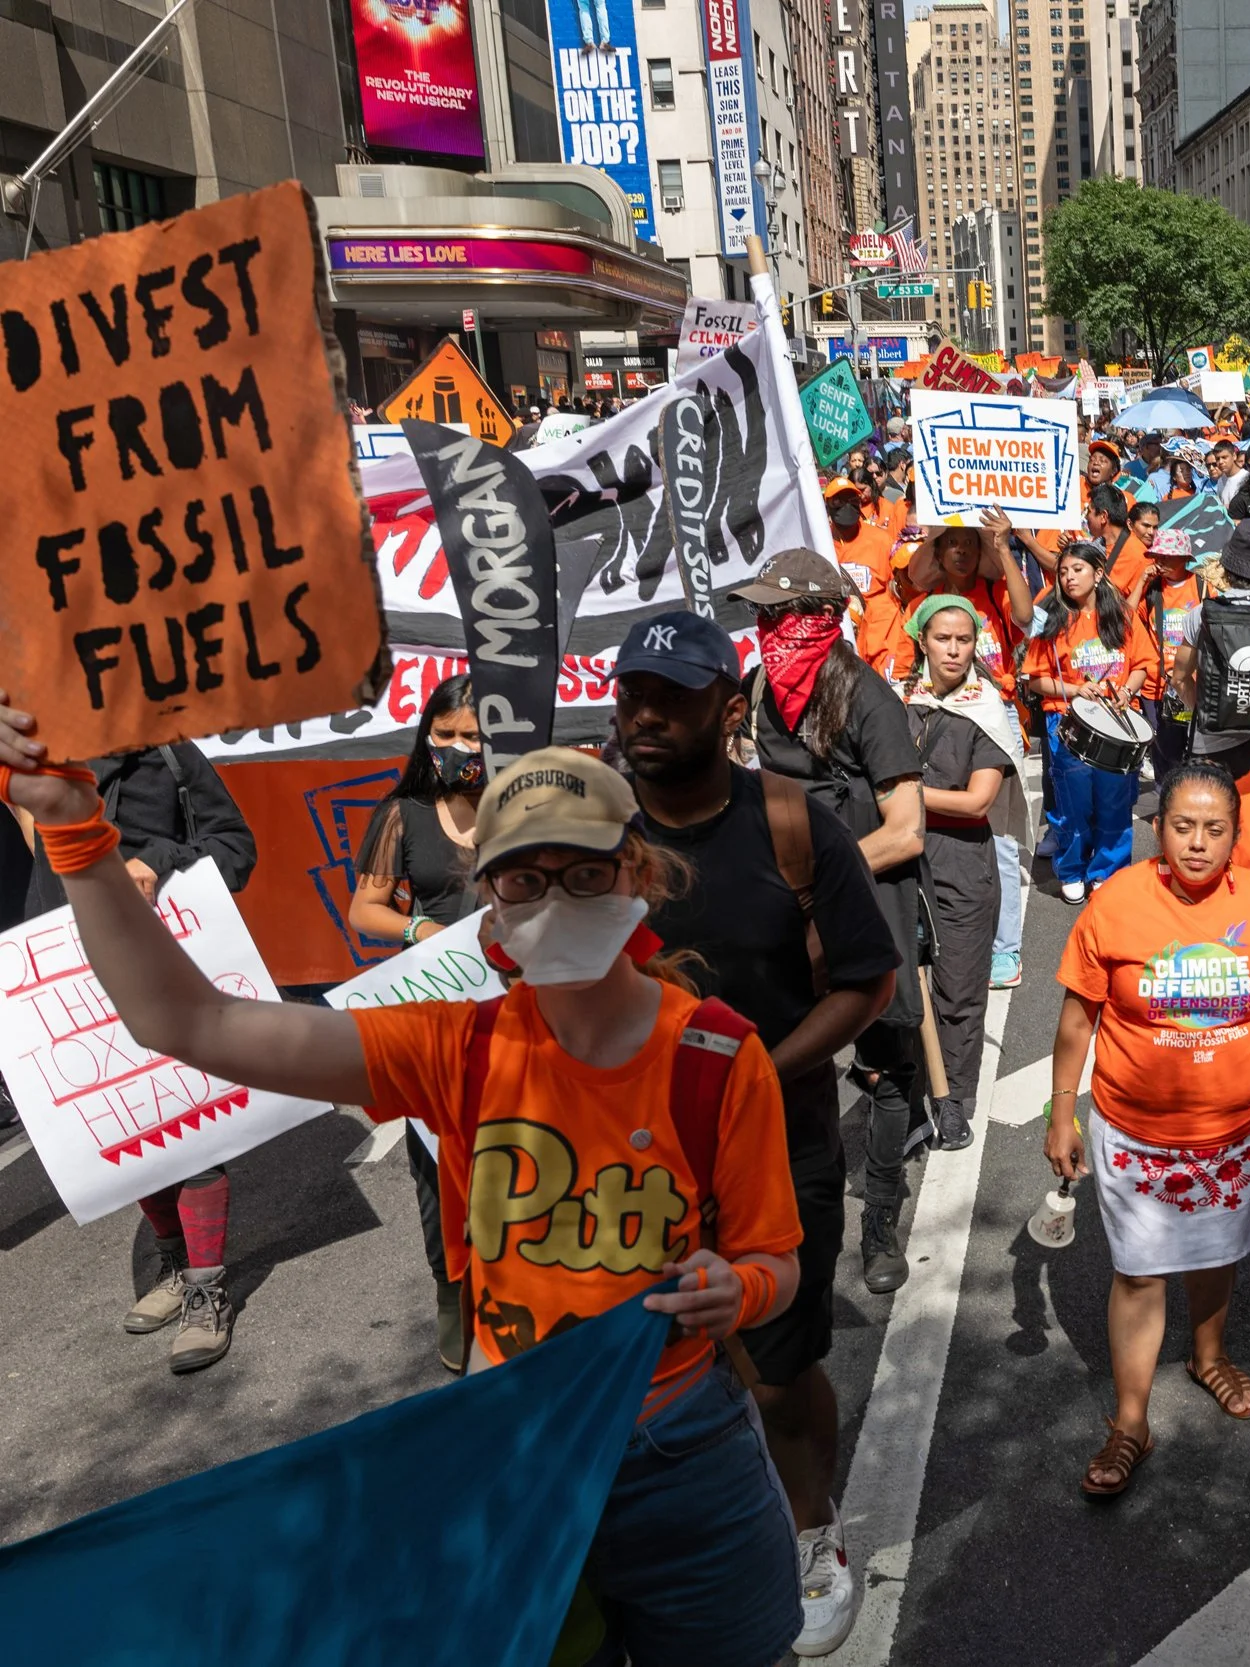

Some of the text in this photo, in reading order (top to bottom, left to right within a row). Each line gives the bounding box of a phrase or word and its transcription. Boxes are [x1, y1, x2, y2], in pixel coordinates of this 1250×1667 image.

[404, 69, 431, 83] THE
[559, 47, 632, 89] HURT
[714, 65, 739, 78] LEASE
[365, 76, 473, 100] REVOLUTIONARY
[716, 79, 740, 97] THIS
[376, 89, 466, 110] NEW MUSICAL
[563, 88, 639, 122] ON THE
[720, 99, 739, 111] SIGN
[717, 112, 744, 125] SPACE
[735, 127, 742, 135] OR
[570, 121, 640, 166] JOB?
[721, 138, 744, 150] PRIME
[721, 149, 745, 160] STREET
[725, 160, 744, 170] LEVEL
[724, 172, 747, 182] RETAIL
[726, 184, 747, 195] SPACE
[725, 196, 751, 206] AVAILABLE
[345, 246, 467, 263] HERE LIES LOVE
[859, 249, 885, 258] PIZZA
[898, 286, 911, 294] 53
[913, 286, 924, 294] St
[0, 236, 262, 393] DIVEST
[585, 357, 603, 367] SALAD
[877, 348, 902, 359] olbert
[981, 355, 998, 365] VOTE
[936, 346, 1001, 395] CLIMATE
[819, 382, 856, 410] GENTE
[819, 399, 849, 425] EN LA
[57, 366, 272, 492] FROM
[544, 428, 561, 438] WE
[813, 414, 849, 442] LUCHA
[947, 436, 1045, 460] NEW YORK
[948, 458, 1039, 473] COMMUNITIES
[948, 472, 1048, 499] CHANGE
[675, 398, 715, 621] CREDIT SUIS
[35, 485, 303, 612] FOSSIL
[433, 435, 540, 668] MORGAN
[74, 582, 322, 710] FUELS
[643, 624, 677, 650] NY
[1226, 670, 1237, 696] THE
[1236, 670, 1250, 714] NORTH
[497, 769, 586, 812] PITTSBURGH
[1154, 956, 1250, 979] CLIMATE
[1150, 993, 1250, 1010] DEFENSORES
[1148, 1006, 1248, 1022] DE LA TIERRA
[1153, 1026, 1249, 1048] WITHOUT FOSSIL FUELS
[1160, 1030, 1212, 1040] BUILDING A
[467, 1117, 690, 1275] Pitt
